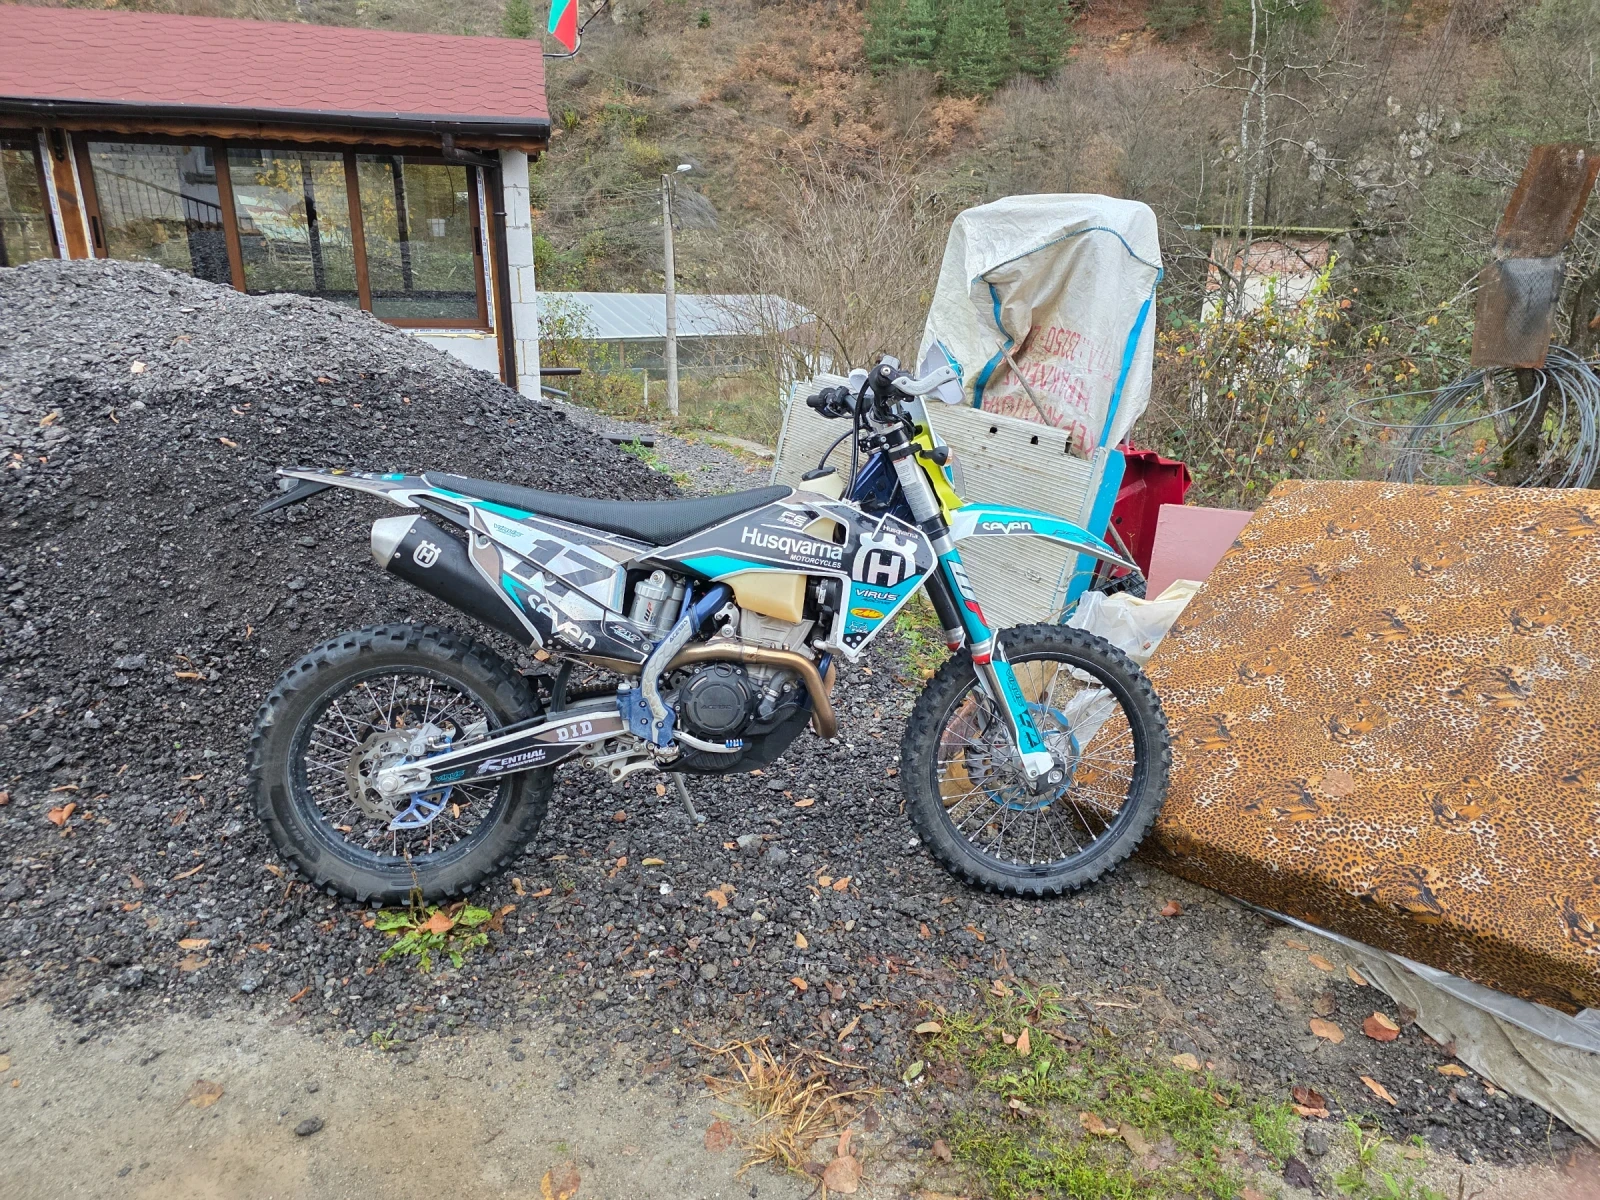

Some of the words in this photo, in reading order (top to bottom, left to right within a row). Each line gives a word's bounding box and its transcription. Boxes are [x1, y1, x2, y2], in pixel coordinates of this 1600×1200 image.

[982, 521, 1032, 535] seven
[740, 526, 843, 560] Husqvarna
[790, 554, 842, 568] MOTORCYCLES
[855, 588, 898, 601] VIRUS
[527, 594, 597, 650] seven
